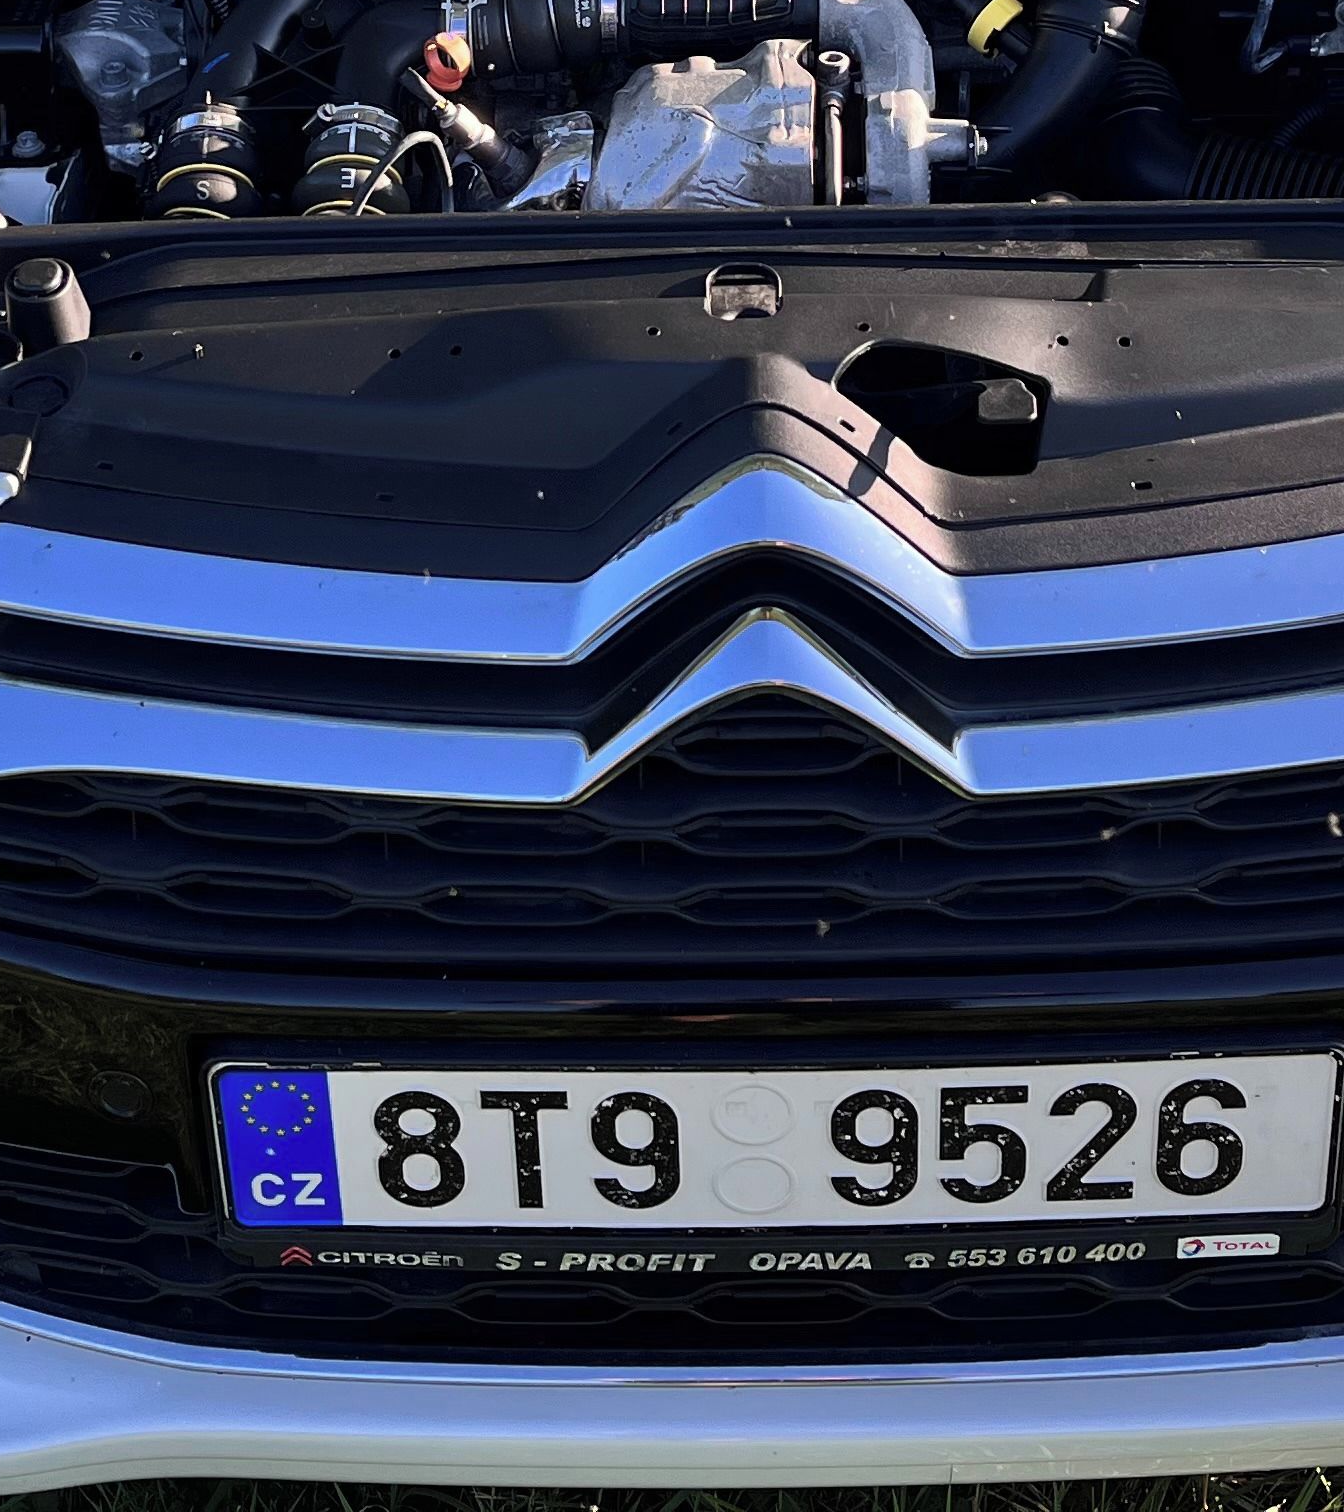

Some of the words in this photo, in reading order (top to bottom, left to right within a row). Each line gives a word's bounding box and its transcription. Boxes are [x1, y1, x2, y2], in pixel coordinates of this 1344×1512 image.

[374, 1090, 681, 1209] 8T9
[830, 1078, 1248, 1207] 9526
[251, 1172, 326, 1206] CZ
[559, 1253, 716, 1271] PROFIT
[749, 1252, 872, 1271] OPAVA
[947, 1248, 1006, 1268] 553
[1016, 1245, 1077, 1265] 610
[1085, 1242, 1147, 1262] 400
